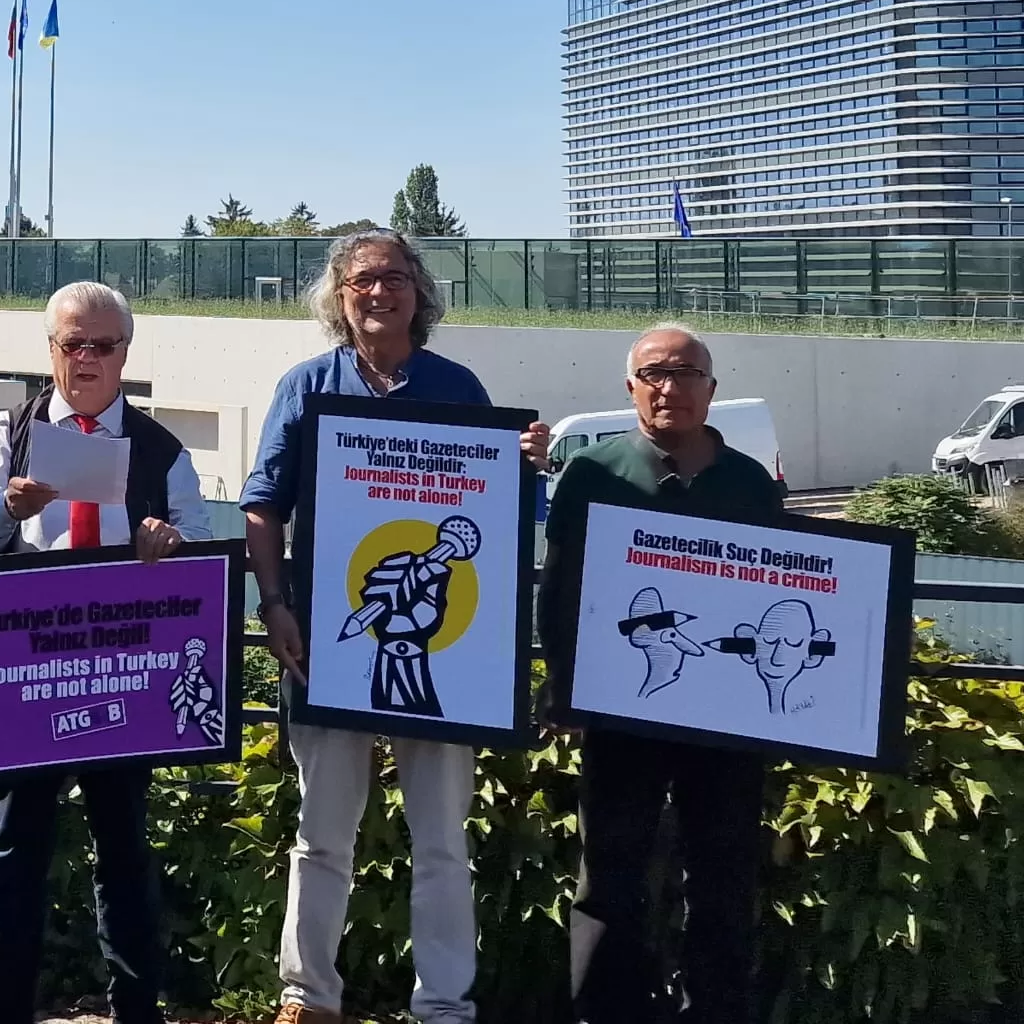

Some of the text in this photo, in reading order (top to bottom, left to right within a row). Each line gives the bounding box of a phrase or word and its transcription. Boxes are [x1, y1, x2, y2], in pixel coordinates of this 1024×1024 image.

[335, 432, 499, 461] Türkiye'deki Gazeteciler
[367, 451, 405, 469] Yalnız
[344, 465, 486, 493] Journalists in Turkey
[368, 485, 462, 506] are not alone!
[632, 529, 833, 574] Gazetecilik Suç Değildir!
[626, 547, 838, 594] Journalism is not a crime!
[94, 655, 112, 674] in
[116, 650, 179, 672] Turkey
[21, 671, 150, 702] are not alone!
[57, 710, 91, 734] ATG
